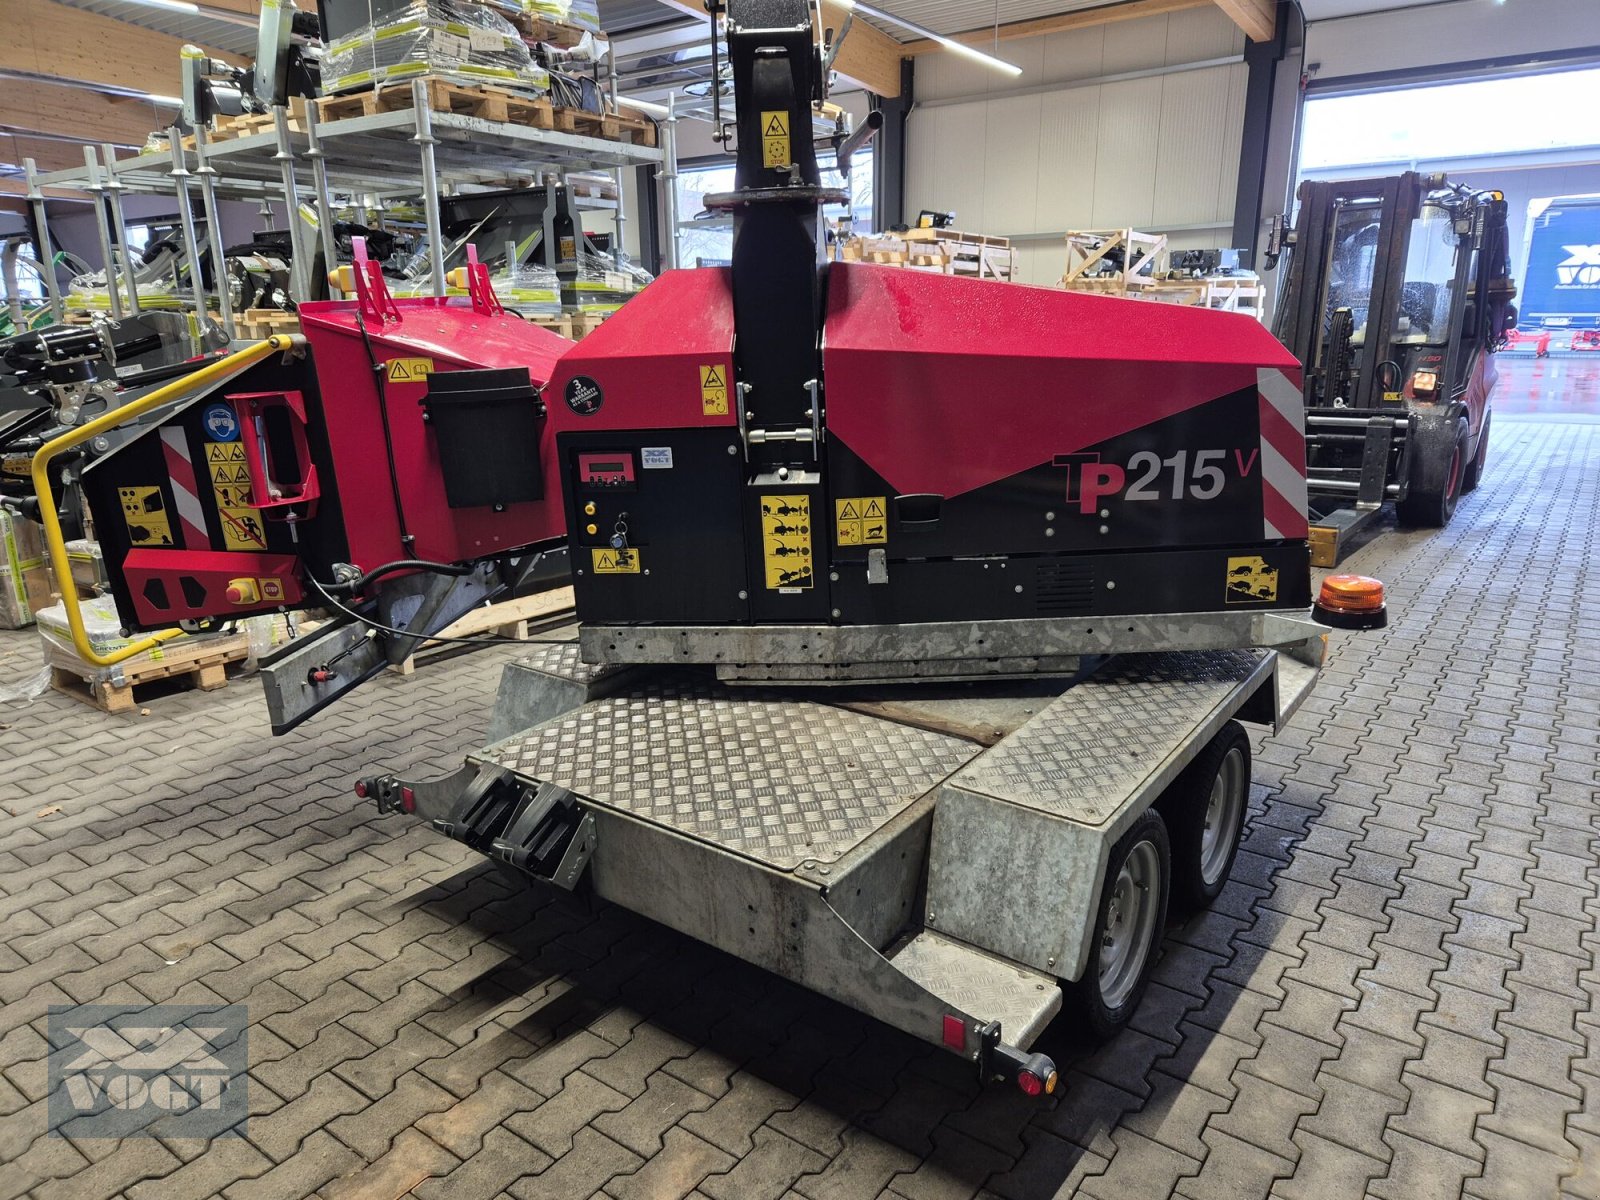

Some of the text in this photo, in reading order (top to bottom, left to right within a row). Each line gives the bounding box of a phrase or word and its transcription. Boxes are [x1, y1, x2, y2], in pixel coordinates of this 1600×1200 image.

[572, 379, 582, 390] 3
[574, 386, 588, 396] YEAR
[570, 386, 597, 403] WARRANTY
[1235, 448, 1259, 477] V
